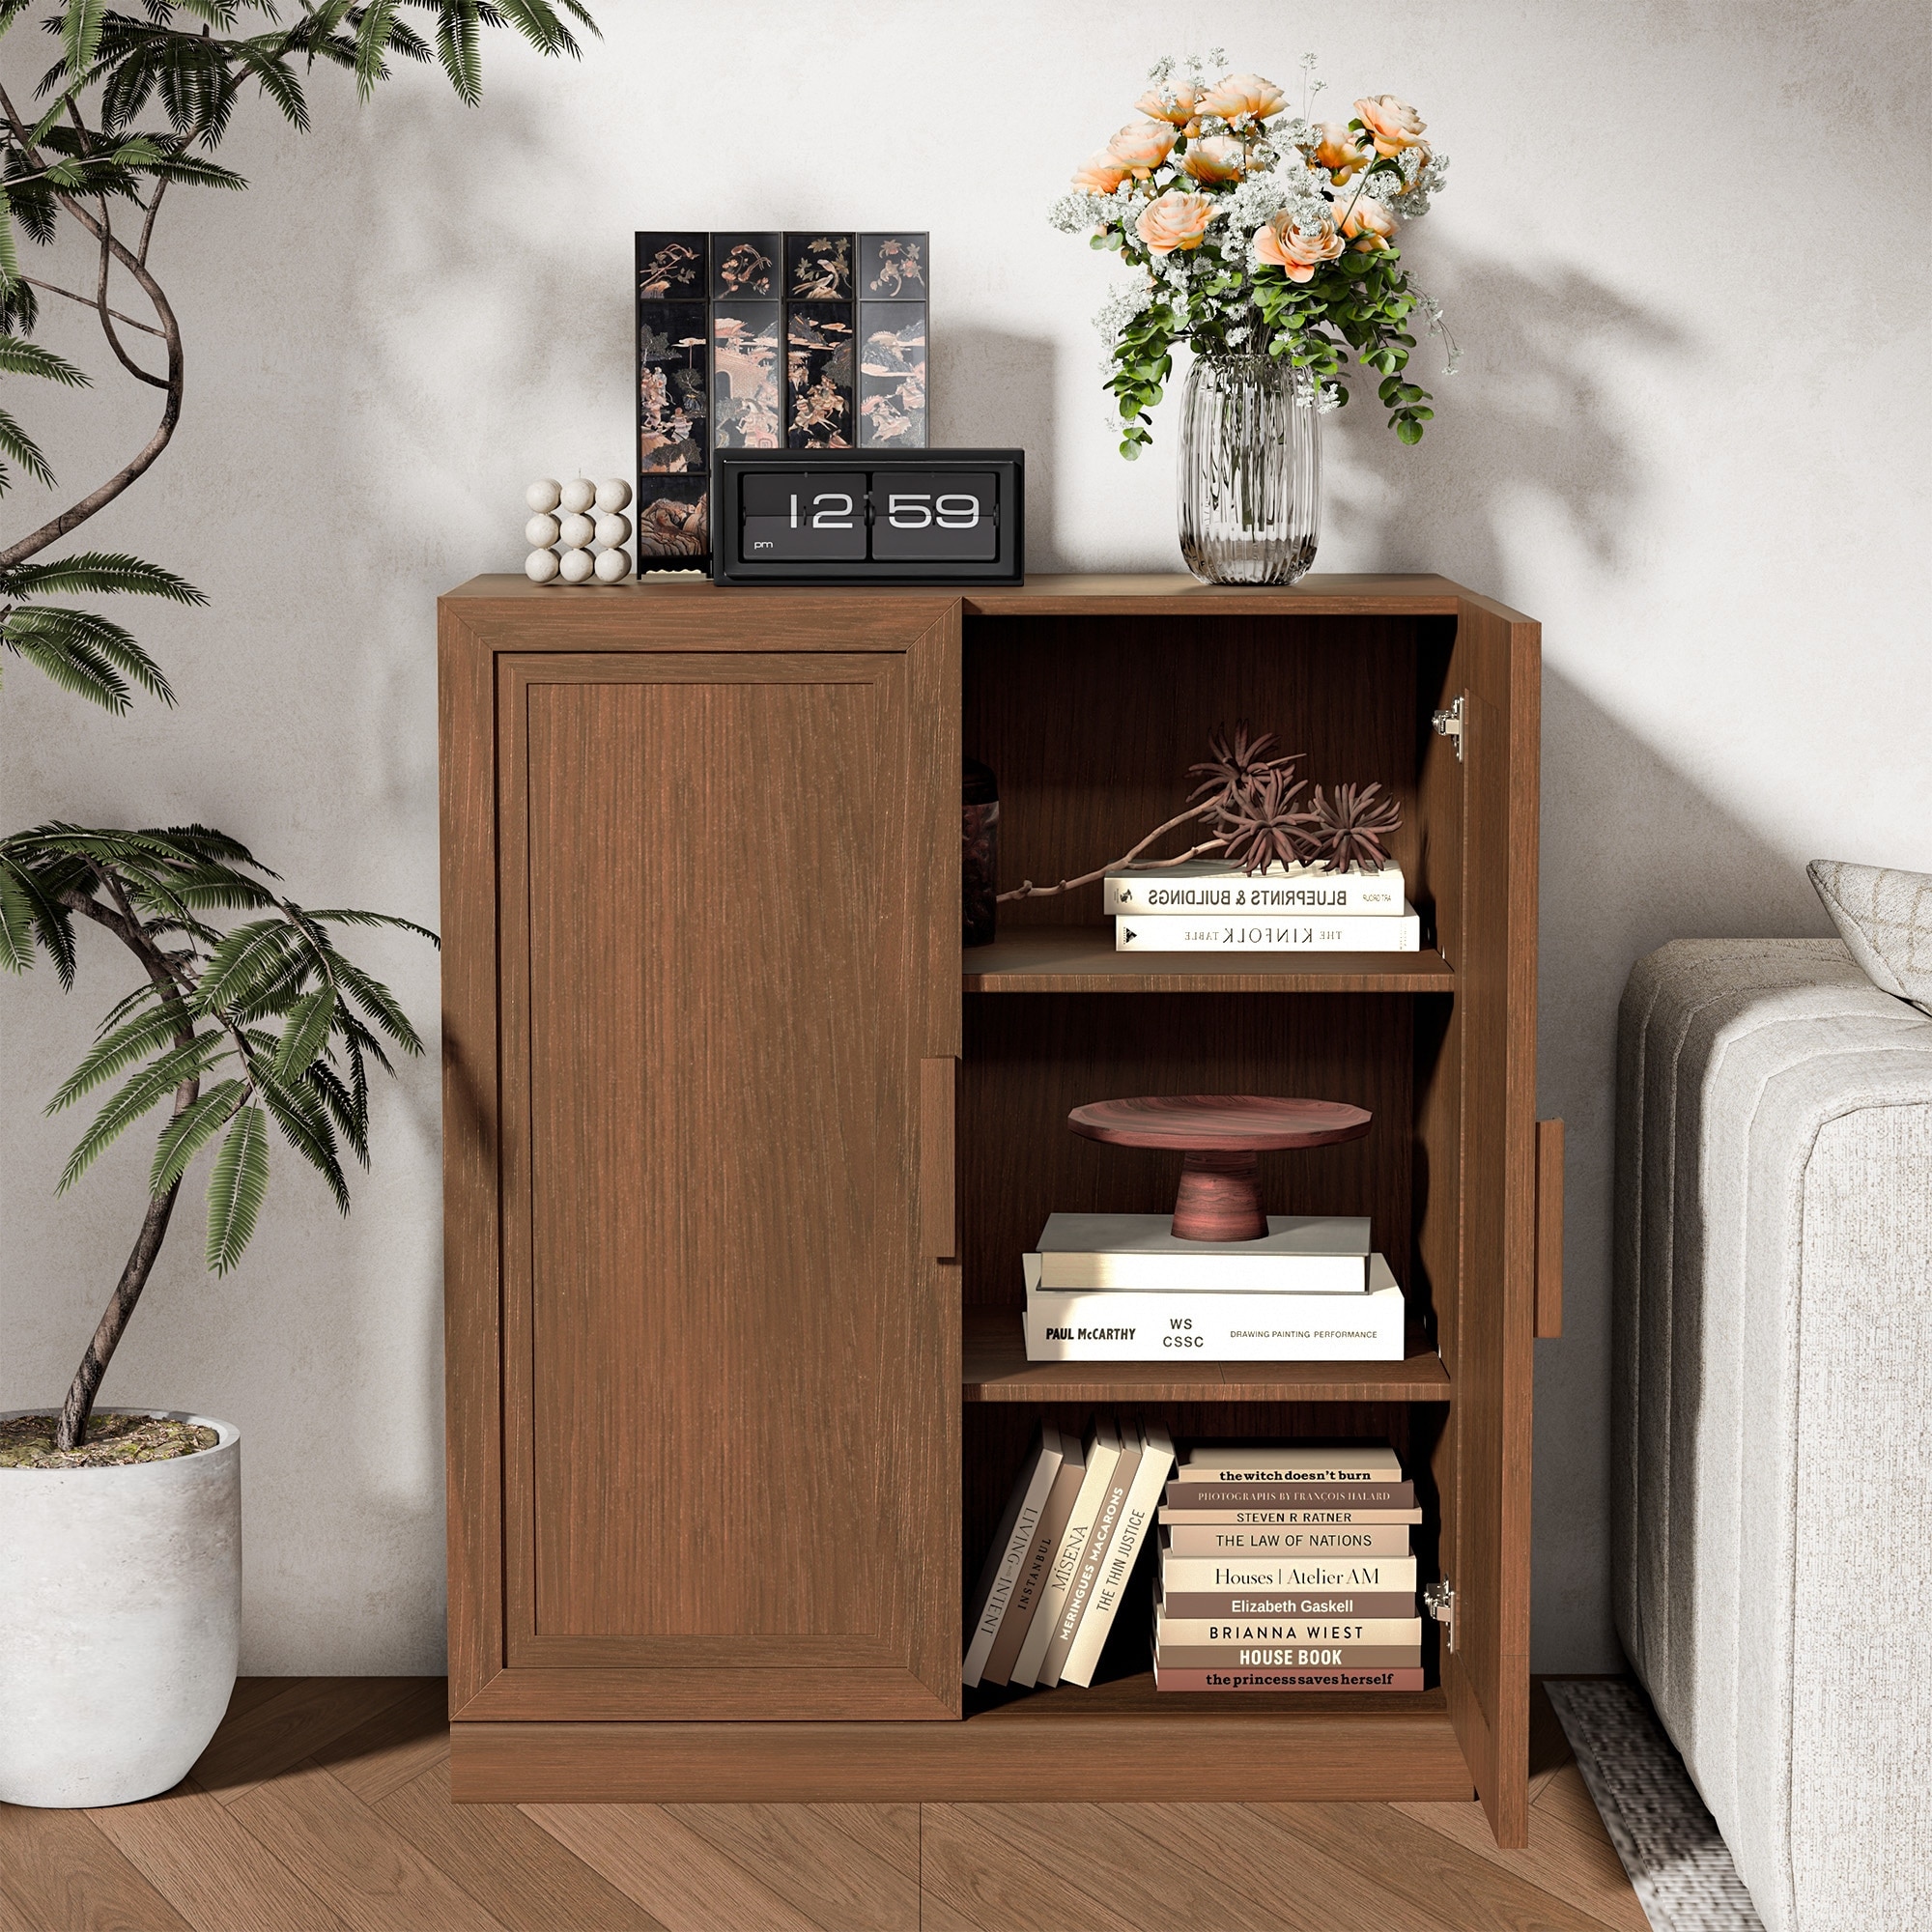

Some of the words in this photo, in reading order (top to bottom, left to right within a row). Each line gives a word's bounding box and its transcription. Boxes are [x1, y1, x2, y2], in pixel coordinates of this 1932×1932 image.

[790, 493, 854, 529] 12
[888, 494, 980, 529] 59
[753, 541, 774, 550] pm
[1169, 1318, 1193, 1330] WS
[1045, 1326, 1075, 1341] PAUL
[1077, 1327, 1136, 1341] McCARTHY
[1230, 1330, 1270, 1339] DRAWING
[1271, 1330, 1311, 1339] PAINTING
[1313, 1330, 1378, 1339] PERFORMANCE
[1162, 1335, 1204, 1349] CSSC
[1219, 1470, 1243, 1482] the
[1243, 1470, 1284, 1481] witch
[1337, 1470, 1372, 1481] burn
[1198, 1492, 1276, 1501] PHOTOGRAPHS
[1279, 1492, 1291, 1501] BY
[1293, 1492, 1346, 1503] FRANÇOIS
[1348, 1492, 1390, 1501] HALARD
[1236, 1512, 1285, 1523] STEVEN
[1290, 1512, 1298, 1522] R
[1302, 1512, 1352, 1522] RATNER
[1007, 1507, 1038, 1565] LIVING
[1215, 1534, 1245, 1548] THE
[1250, 1534, 1280, 1548] LAW
[1285, 1534, 1304, 1548] OF
[1309, 1534, 1373, 1547] NATIONS
[1060, 1564, 1094, 1640] MERINGUES
[1089, 1487, 1123, 1562] MACARONS
[1096, 1588, 1116, 1612] THE
[1106, 1558, 1126, 1586] THIN
[1120, 1508, 1146, 1558] JUSTICE
[1017, 1538, 1052, 1610] INSTANBUL
[1215, 1568, 1273, 1585] Houses
[1287, 1567, 1344, 1585] Atelier
[1346, 1568, 1378, 1584] AM
[980, 1577, 1012, 1636] INTENT
[1232, 1599, 1296, 1613] Elizabeth
[1300, 1599, 1353, 1613] Gaskell
[1209, 1626, 1297, 1639] BRIANNA
[1306, 1626, 1363, 1639] WIEST
[1239, 1649, 1293, 1665] HOUSE
[1297, 1649, 1343, 1665] BOOK
[1206, 1673, 1232, 1686] the
[1232, 1673, 1297, 1689] princess
[1297, 1676, 1340, 1686] saves
[1340, 1672, 1395, 1686] herself
